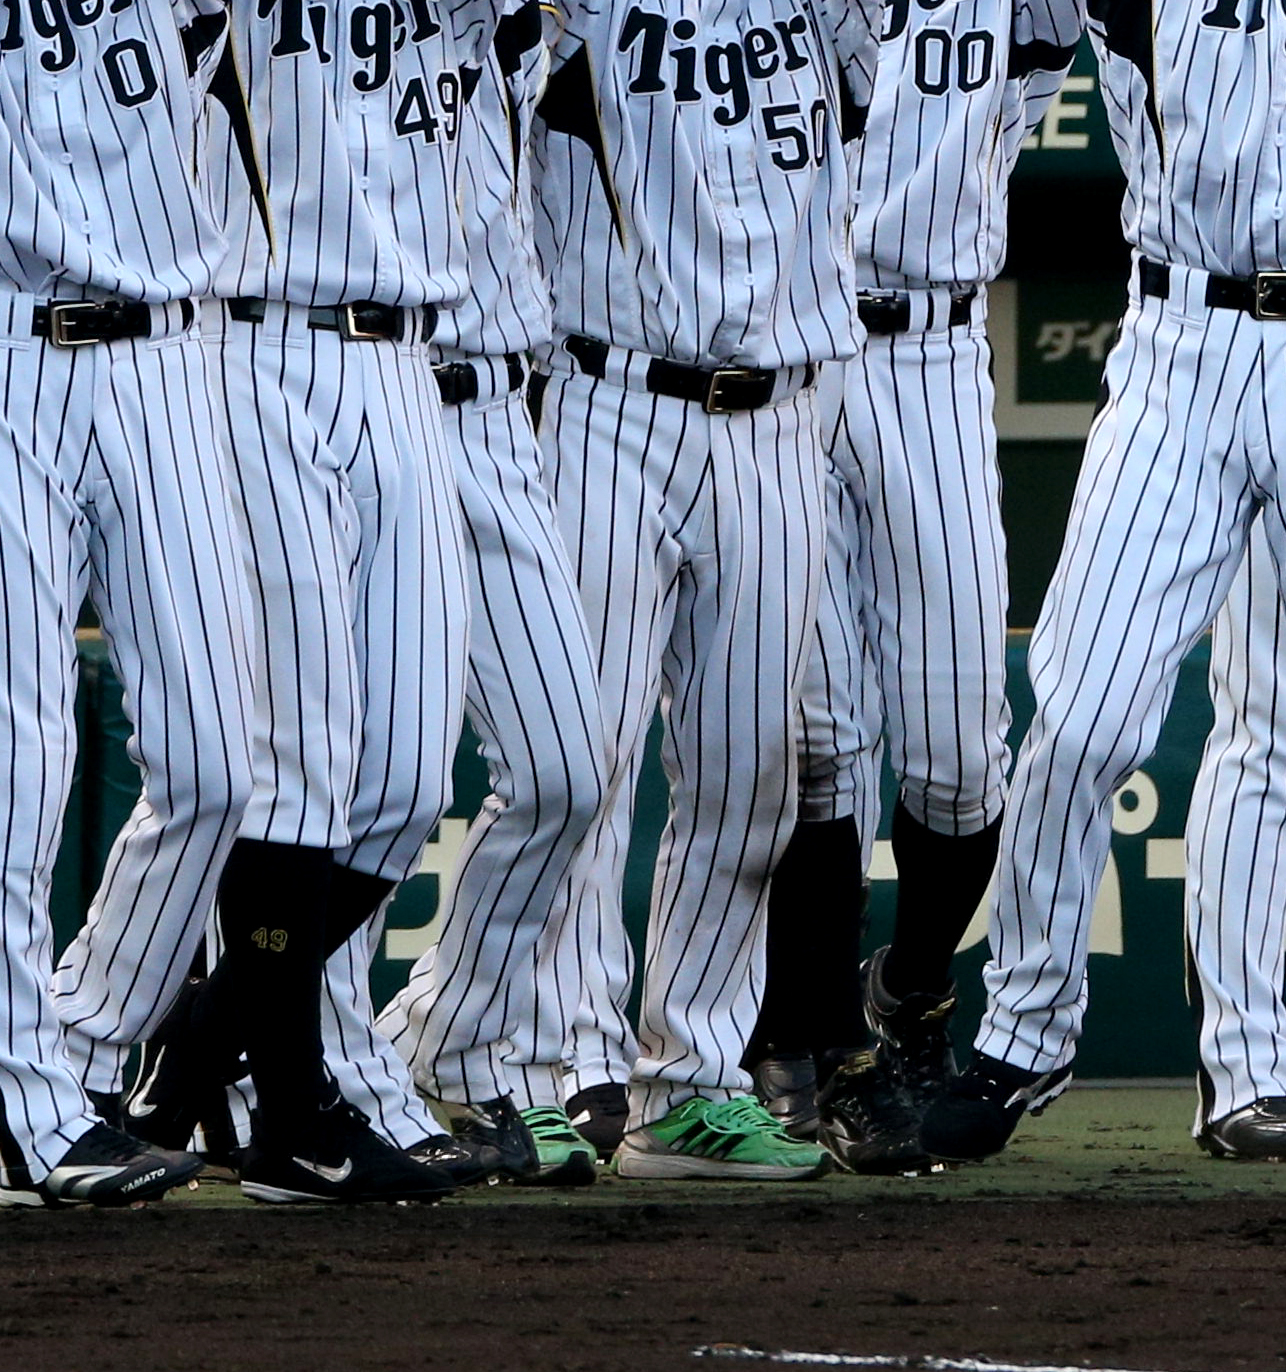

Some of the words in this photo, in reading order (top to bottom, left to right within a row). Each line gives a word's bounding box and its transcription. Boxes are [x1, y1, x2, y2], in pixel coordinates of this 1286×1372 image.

[618, 5, 809, 128] Tiger
[913, 27, 995, 98] 00
[394, 70, 462, 147] 49
[760, 98, 827, 174] 50
[250, 926, 289, 953] 49
[119, 1167, 167, 1195] YAMATO
